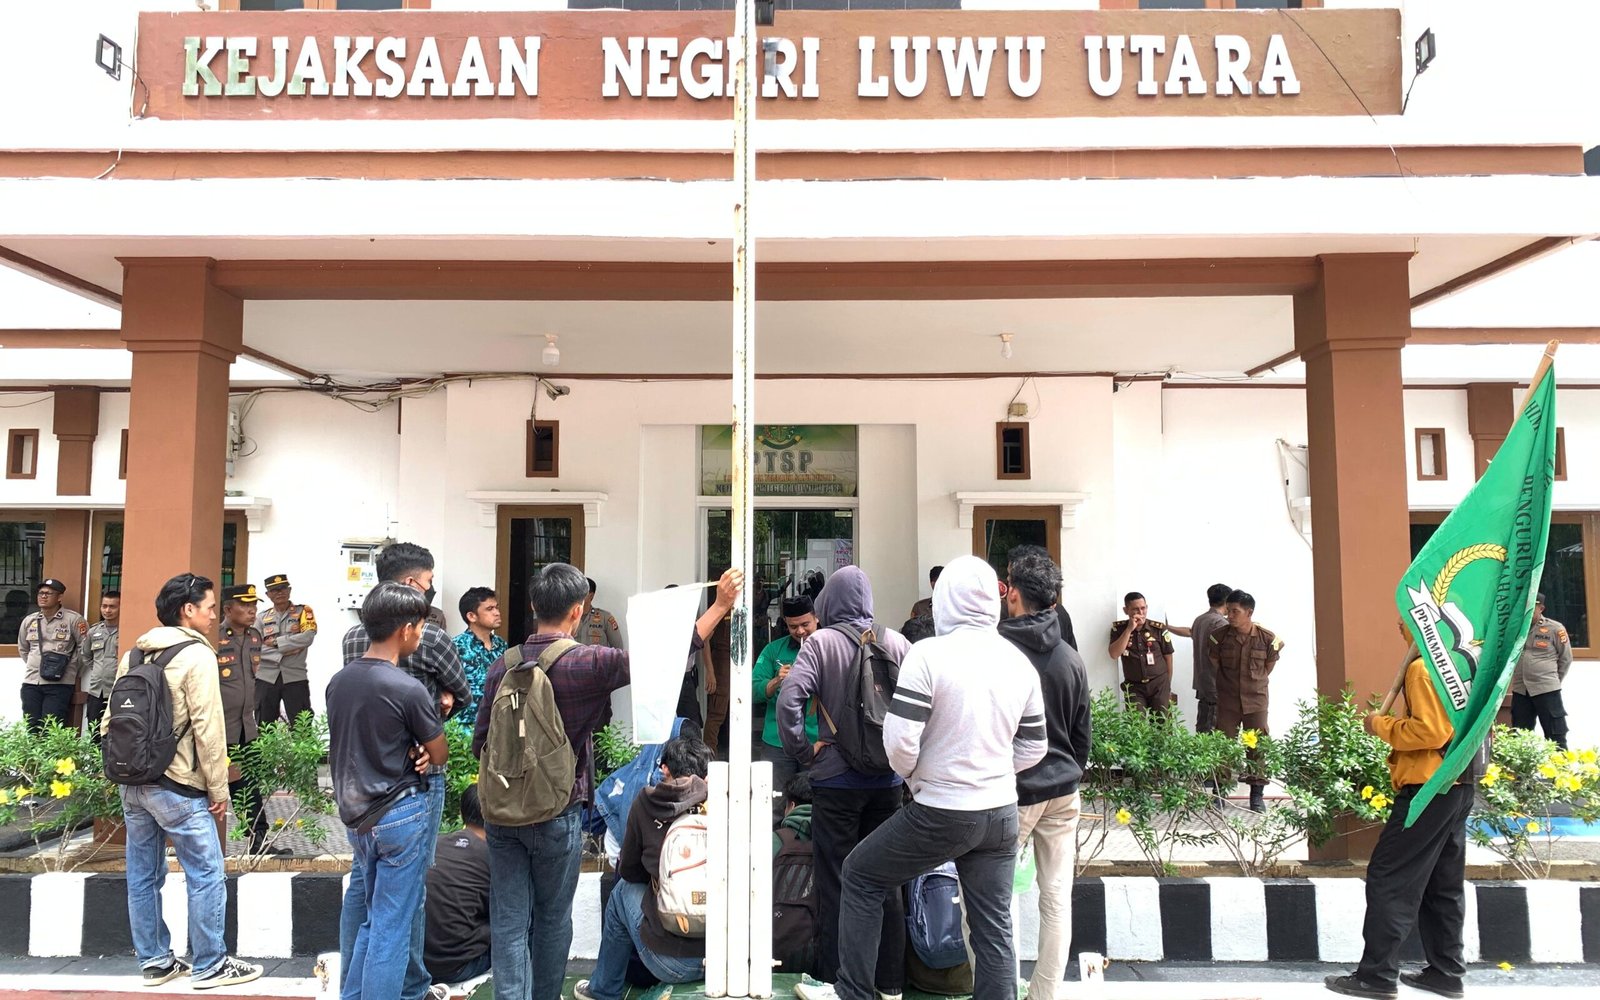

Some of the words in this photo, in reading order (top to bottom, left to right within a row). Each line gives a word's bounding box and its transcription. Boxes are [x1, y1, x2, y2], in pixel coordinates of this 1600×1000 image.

[183, 36, 540, 98] KEJAKSAAN
[858, 36, 1046, 98] LUWU
[1084, 33, 1302, 97] UTARA
[1414, 608, 1466, 707] PP-HIKMAH-LUTRA
